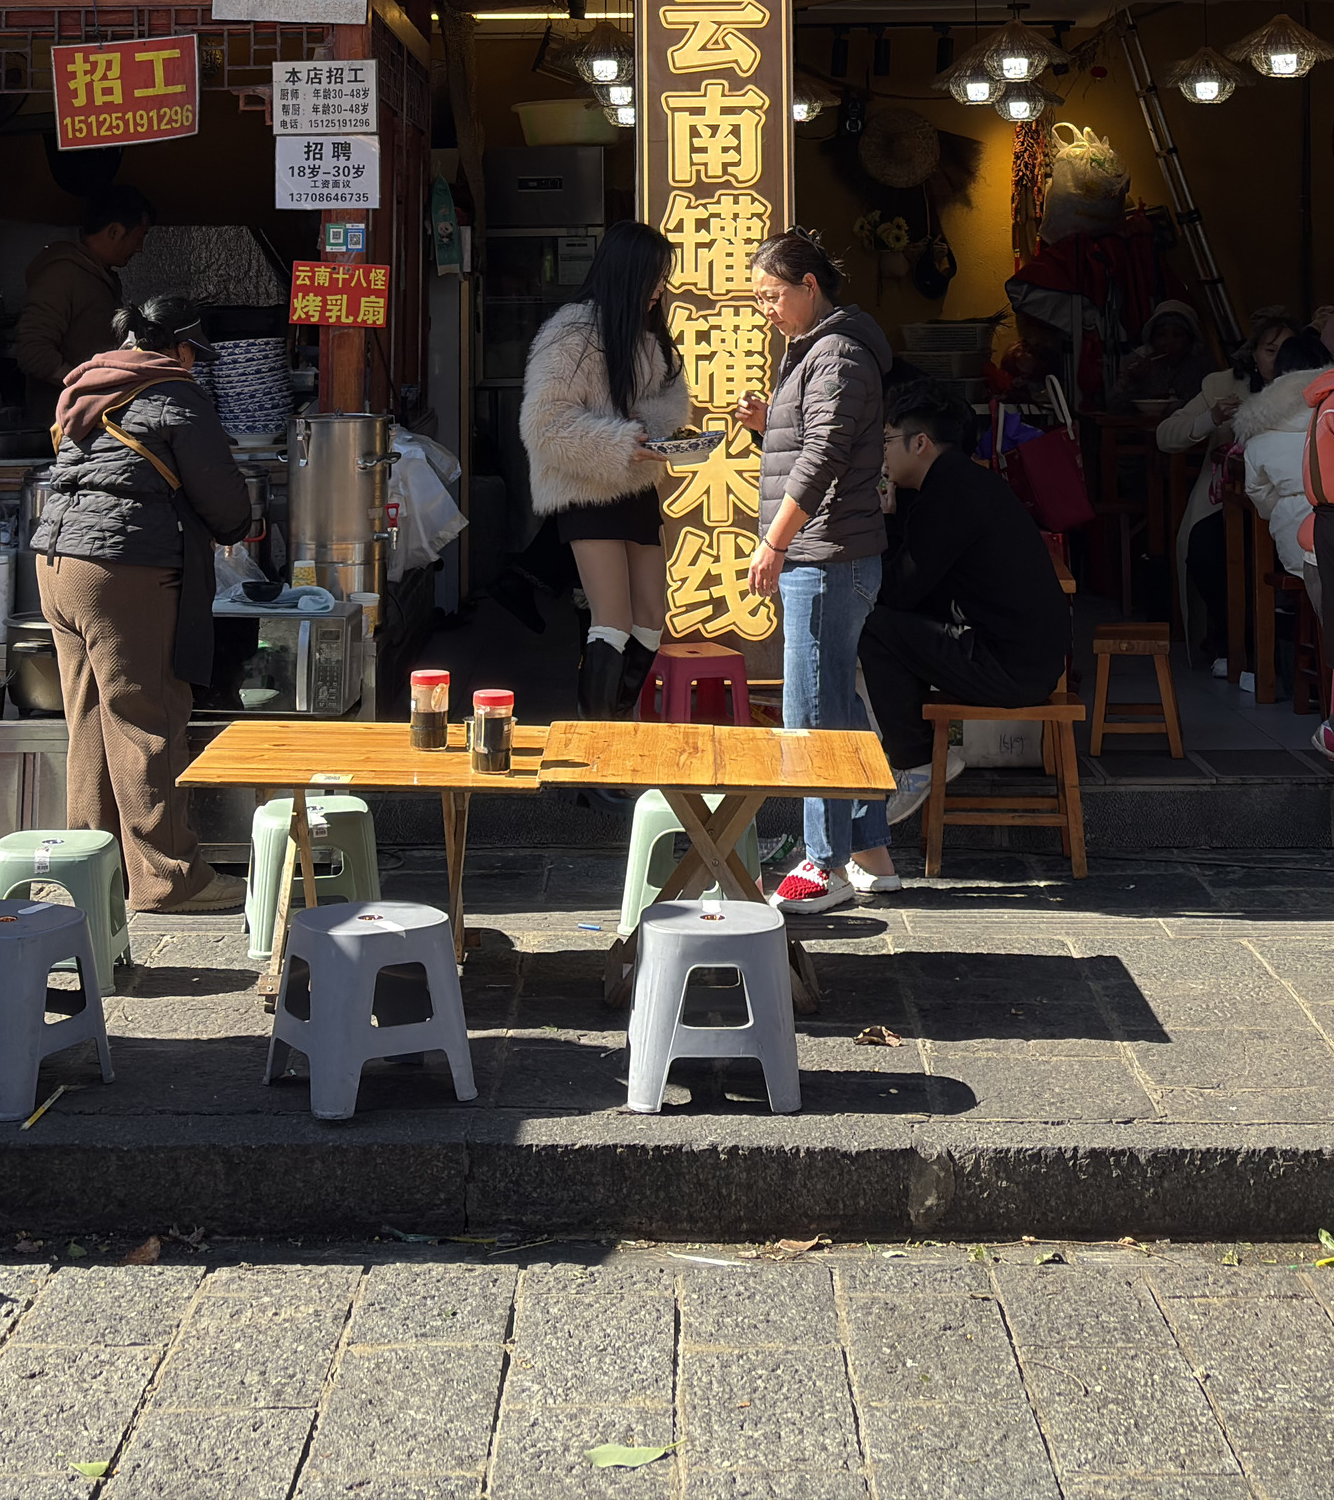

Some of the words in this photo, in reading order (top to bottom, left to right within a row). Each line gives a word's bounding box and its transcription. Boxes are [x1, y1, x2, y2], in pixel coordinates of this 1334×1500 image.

[66, 47, 188, 108] 招工
[284, 67, 366, 86] 本店招工
[62, 104, 194, 140] 15125191296
[308, 118, 371, 129] 15125191296
[303, 141, 353, 162] 招聘
[310, 178, 352, 190] 工资面议
[288, 192, 370, 203] 13708646735
[295, 265, 387, 290] 云南十八怪
[292, 292, 386, 326] 烤乳扇
